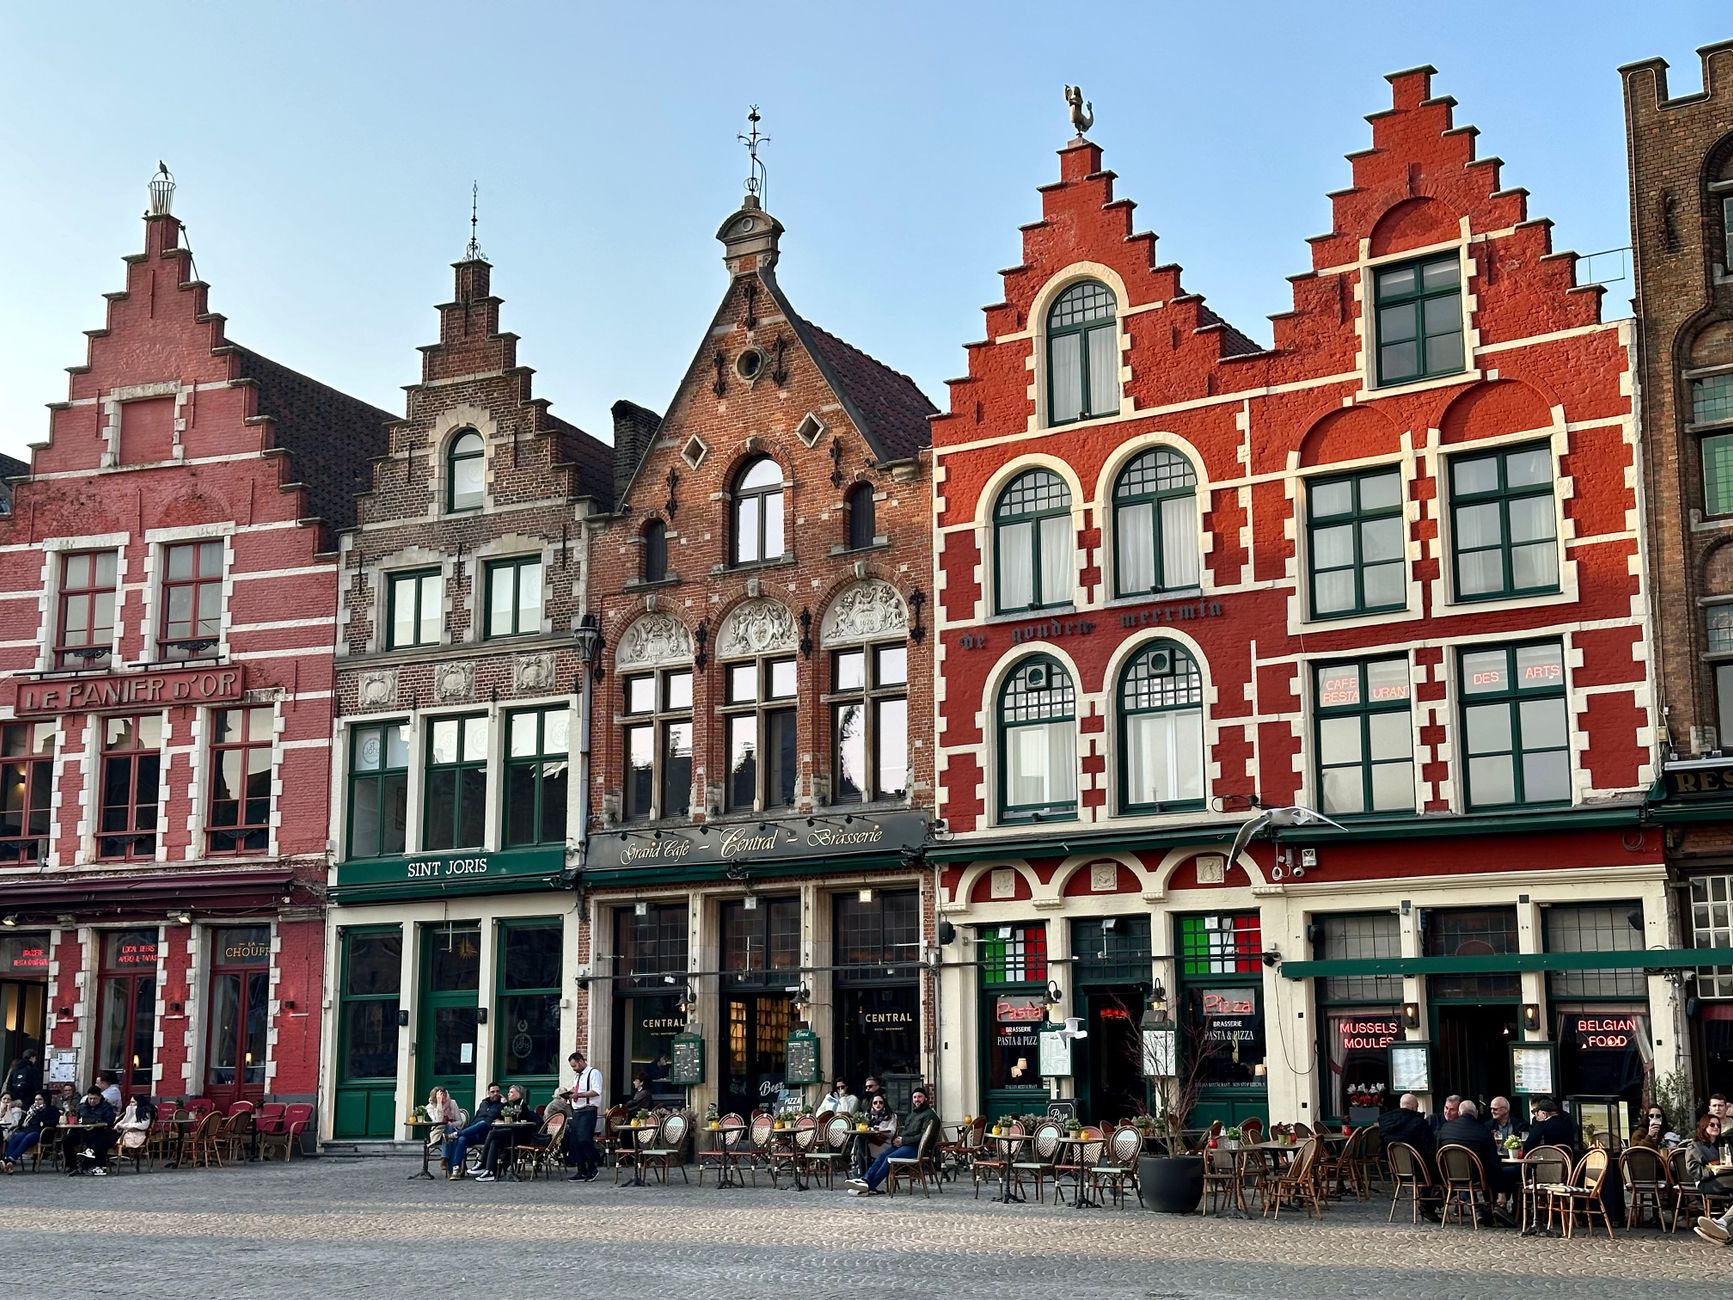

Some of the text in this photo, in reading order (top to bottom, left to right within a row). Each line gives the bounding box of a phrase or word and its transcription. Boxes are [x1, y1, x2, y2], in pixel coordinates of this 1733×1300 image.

[1473, 665, 1561, 685] DES ARTS
[1325, 678, 1356, 691] CAFE
[26, 690, 59, 711] LE
[65, 678, 165, 708] PANIER
[620, 842, 662, 866] Grand
[719, 827, 779, 859] Central
[806, 828, 883, 848] Brasserie
[407, 858, 488, 878] SINT JORIS
[997, 1001, 1042, 1020] Pasta
[1203, 994, 1251, 1015] Pizza
[642, 1018, 684, 1028] CENTRAL
[865, 1012, 912, 1023] CENTRAL
[1340, 1022, 1398, 1034] MUSSELS
[1578, 1019, 1636, 1032] BELGIAN
[997, 1036, 1016, 1046] PASTA
[1205, 1031, 1226, 1041] PASTA
[1233, 1030, 1254, 1040] PIZZA
[1589, 1035, 1628, 1047] FOOD
